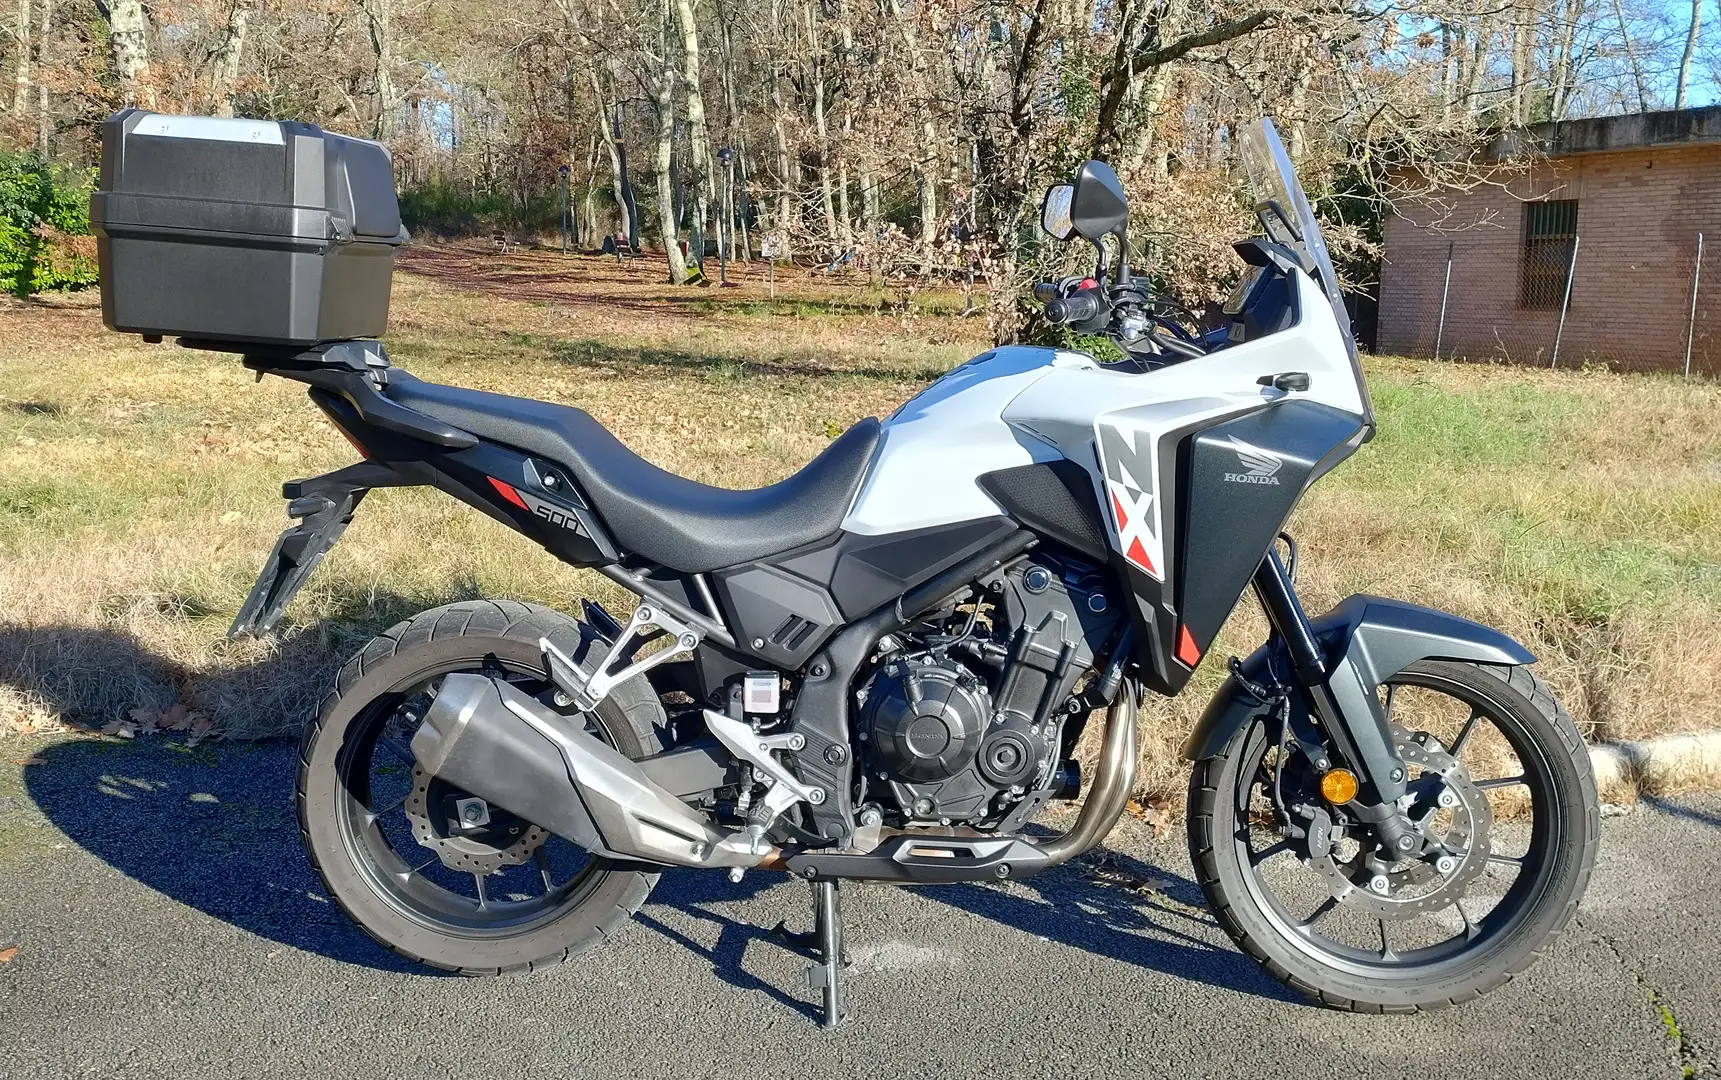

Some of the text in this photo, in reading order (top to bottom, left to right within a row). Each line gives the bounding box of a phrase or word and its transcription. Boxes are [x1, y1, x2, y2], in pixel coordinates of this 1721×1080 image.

[1224, 473, 1280, 485] HONDA
[536, 505, 579, 532] 500
[910, 732, 945, 740] HONDA
